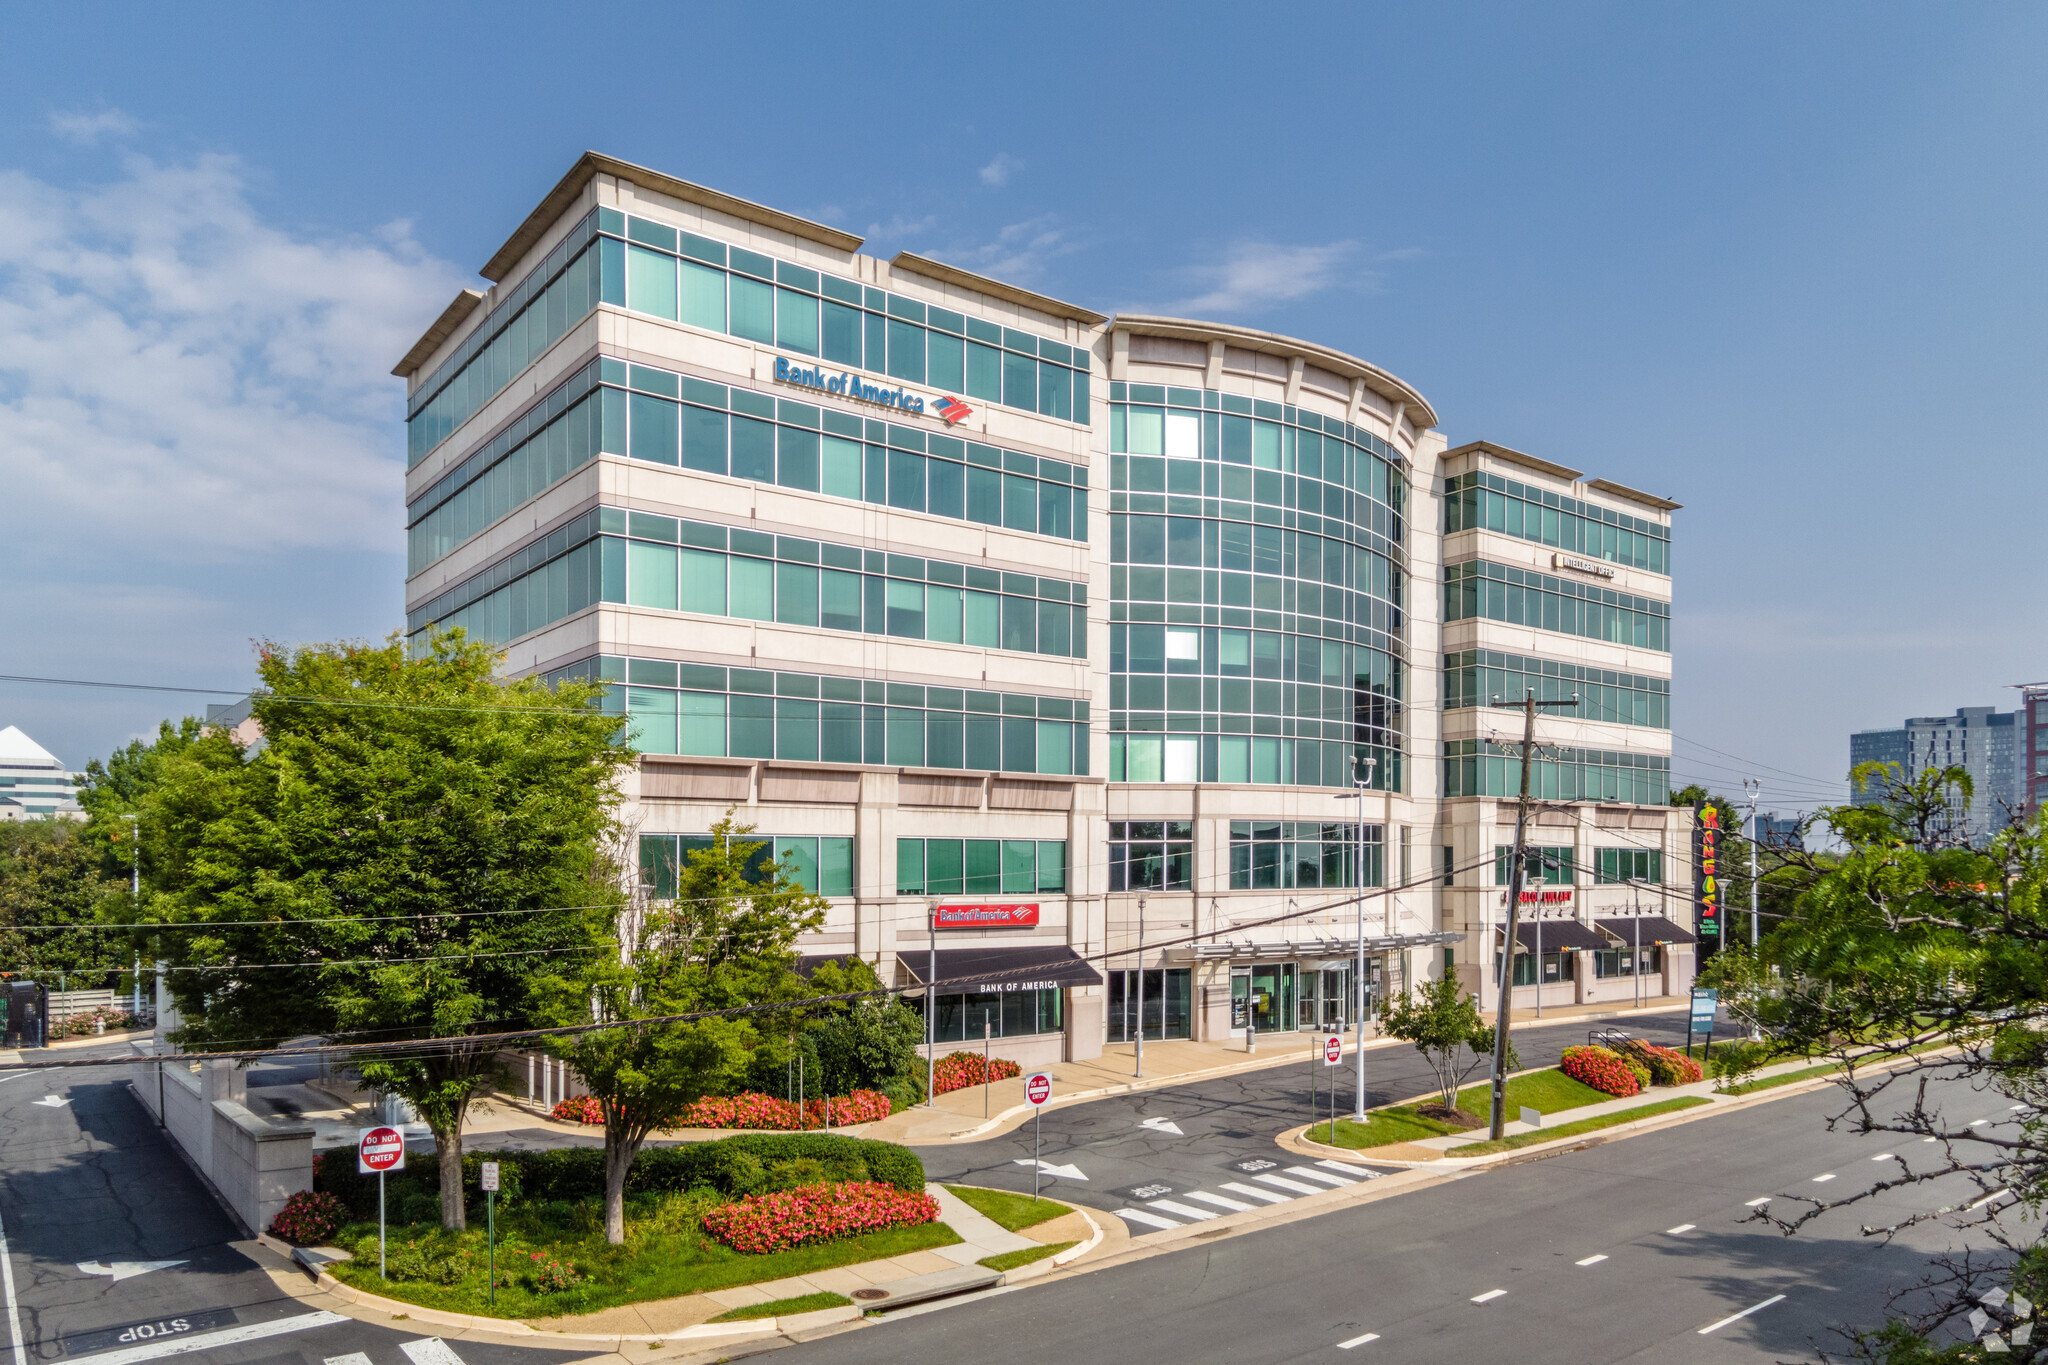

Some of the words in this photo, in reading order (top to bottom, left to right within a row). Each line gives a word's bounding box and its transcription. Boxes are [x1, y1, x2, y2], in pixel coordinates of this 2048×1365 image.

[776, 357, 825, 390] Bank
[828, 372, 848, 395] of
[849, 375, 925, 414] America
[1564, 556, 1598, 573] INTELLIGENT
[1543, 891, 1572, 903] LULLABY
[940, 909, 965, 922] Bank
[965, 908, 975, 921] of
[975, 908, 1011, 921] America
[980, 983, 1003, 993] BANK
[1006, 982, 1018, 992] OF
[1021, 980, 1058, 991] AMERICA
[367, 1136, 378, 1144] DO
[370, 1154, 394, 1163] ENTER
[118, 1318, 192, 1342] STOP
